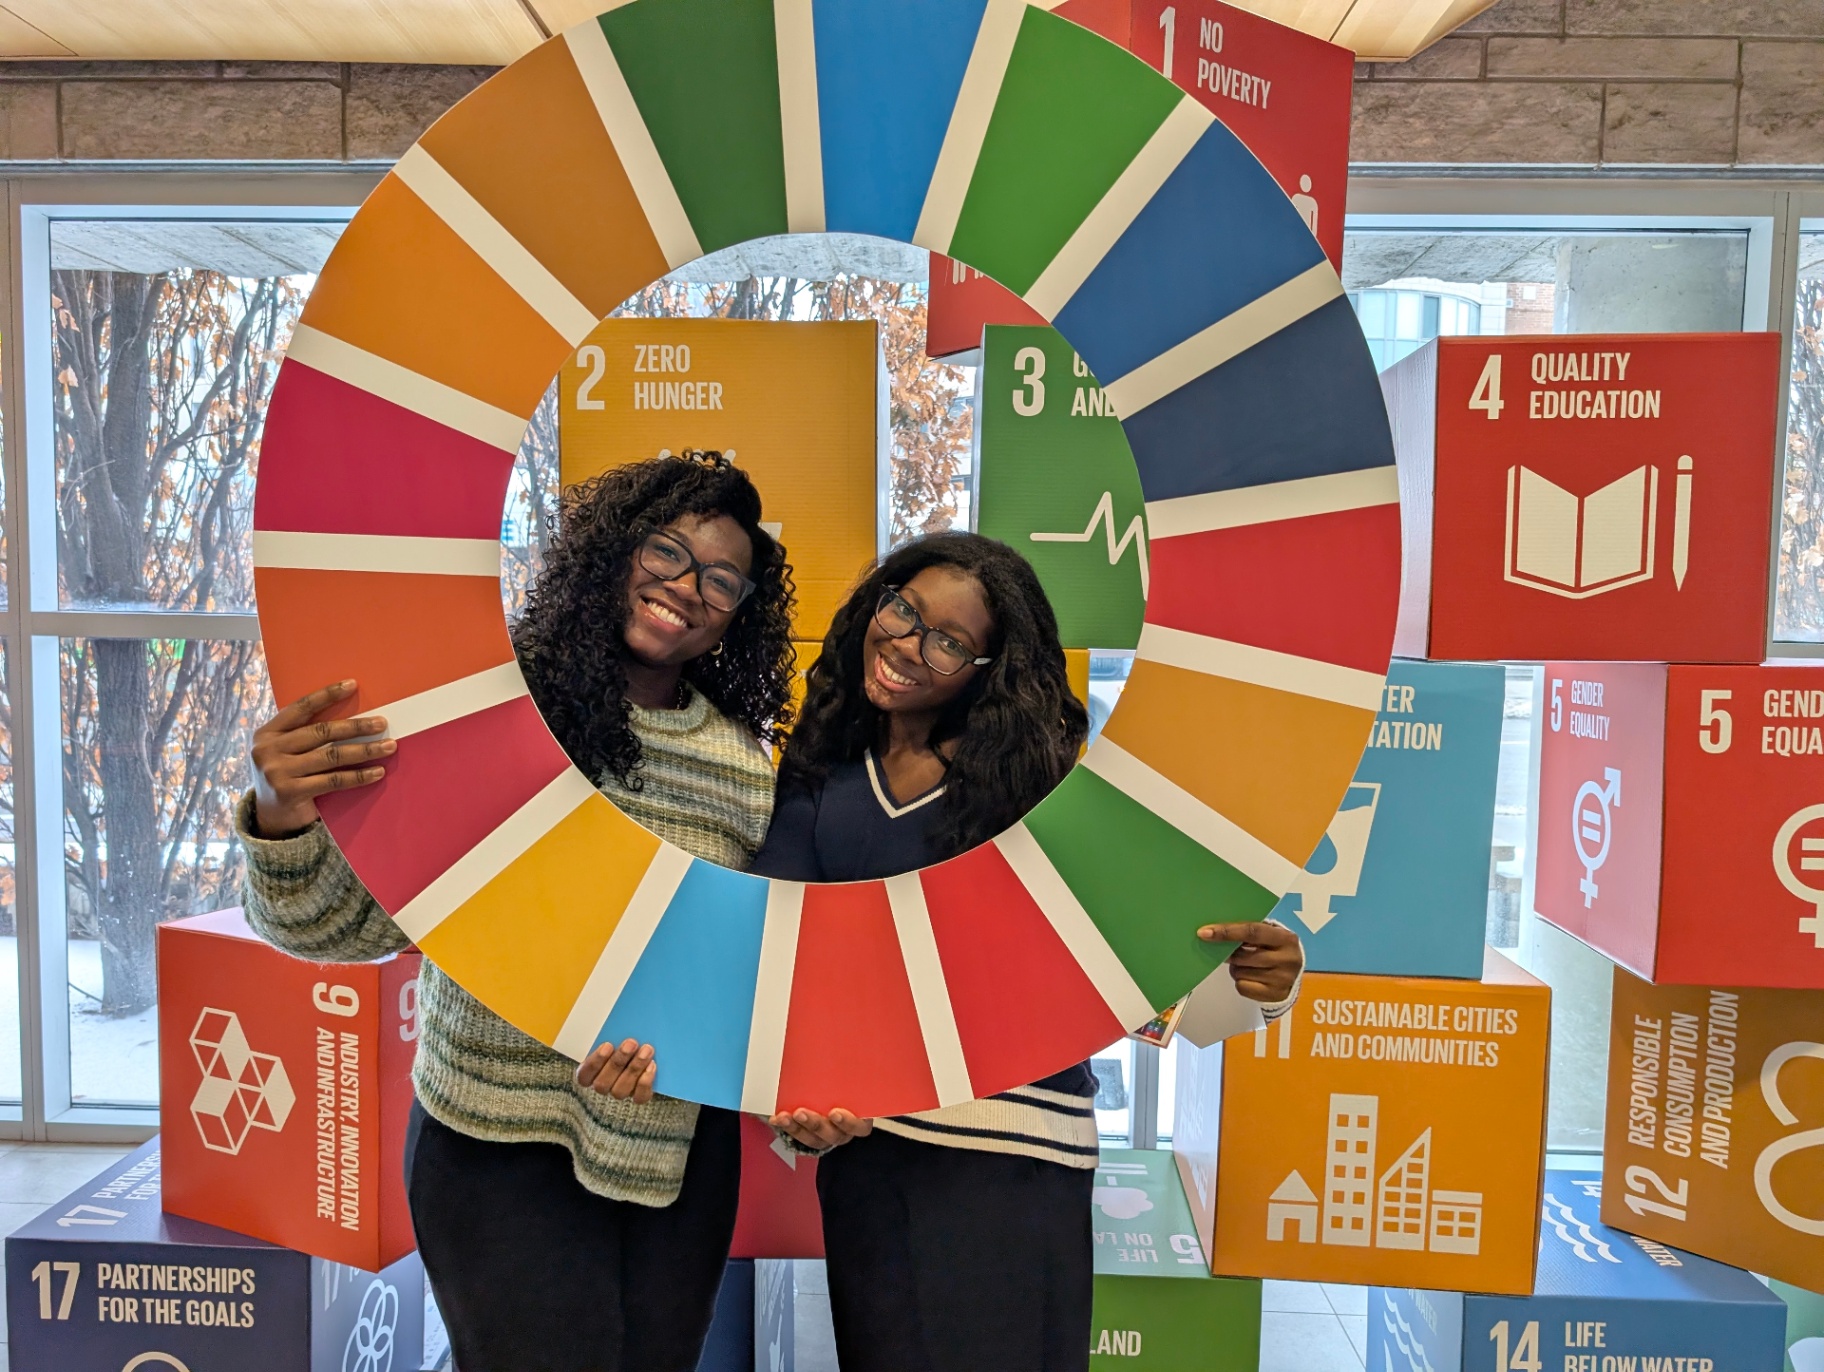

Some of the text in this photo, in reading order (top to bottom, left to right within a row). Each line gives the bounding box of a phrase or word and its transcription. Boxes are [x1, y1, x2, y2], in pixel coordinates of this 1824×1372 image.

[1160, 6, 1176, 80] 1
[1200, 17, 1223, 53] NO
[1197, 57, 1271, 109] POVERTY
[634, 344, 691, 373] ZERO
[1531, 352, 1631, 385] QUALITY
[577, 345, 605, 410] 2
[1012, 347, 1045, 416] 3
[1468, 354, 1504, 420] 4
[634, 382, 723, 411] HUNGER
[1529, 390, 1661, 419] EDUCATION
[1550, 679, 1563, 732] 5
[1571, 680, 1604, 708] GENDER
[1763, 689, 1824, 718] GEND
[1570, 711, 1610, 741] EQUALITY
[1699, 689, 1732, 754] 5
[1761, 726, 1824, 757] EQUA
[312, 982, 360, 1018] 9
[399, 979, 420, 1042] 9
[1312, 998, 1518, 1035] SUSTAINABLE CITIES
[1310, 1032, 1499, 1067] AND COMMUNITIES
[1627, 1014, 1662, 1149] RESPONSIBLE
[1663, 1012, 1699, 1158] CONSUMPTION
[1700, 990, 1739, 1170] AND PRODUCTION
[317, 1026, 336, 1222] AND INFRASTRUCTURE
[340, 1031, 360, 1231] INDUSTRY, INNOVATION
[1624, 1165, 1689, 1222] 12
[56, 1204, 128, 1228] 17
[1116, 1248, 1158, 1263] LIFE
[1124, 1232, 1154, 1246] ON
[32, 1261, 80, 1320] 17
[98, 1263, 255, 1295] PARTNERSHIPS
[98, 1296, 254, 1328] FOR THE GOALS
[1490, 1320, 1542, 1372] 14
[1565, 1321, 1606, 1348] LIFE
